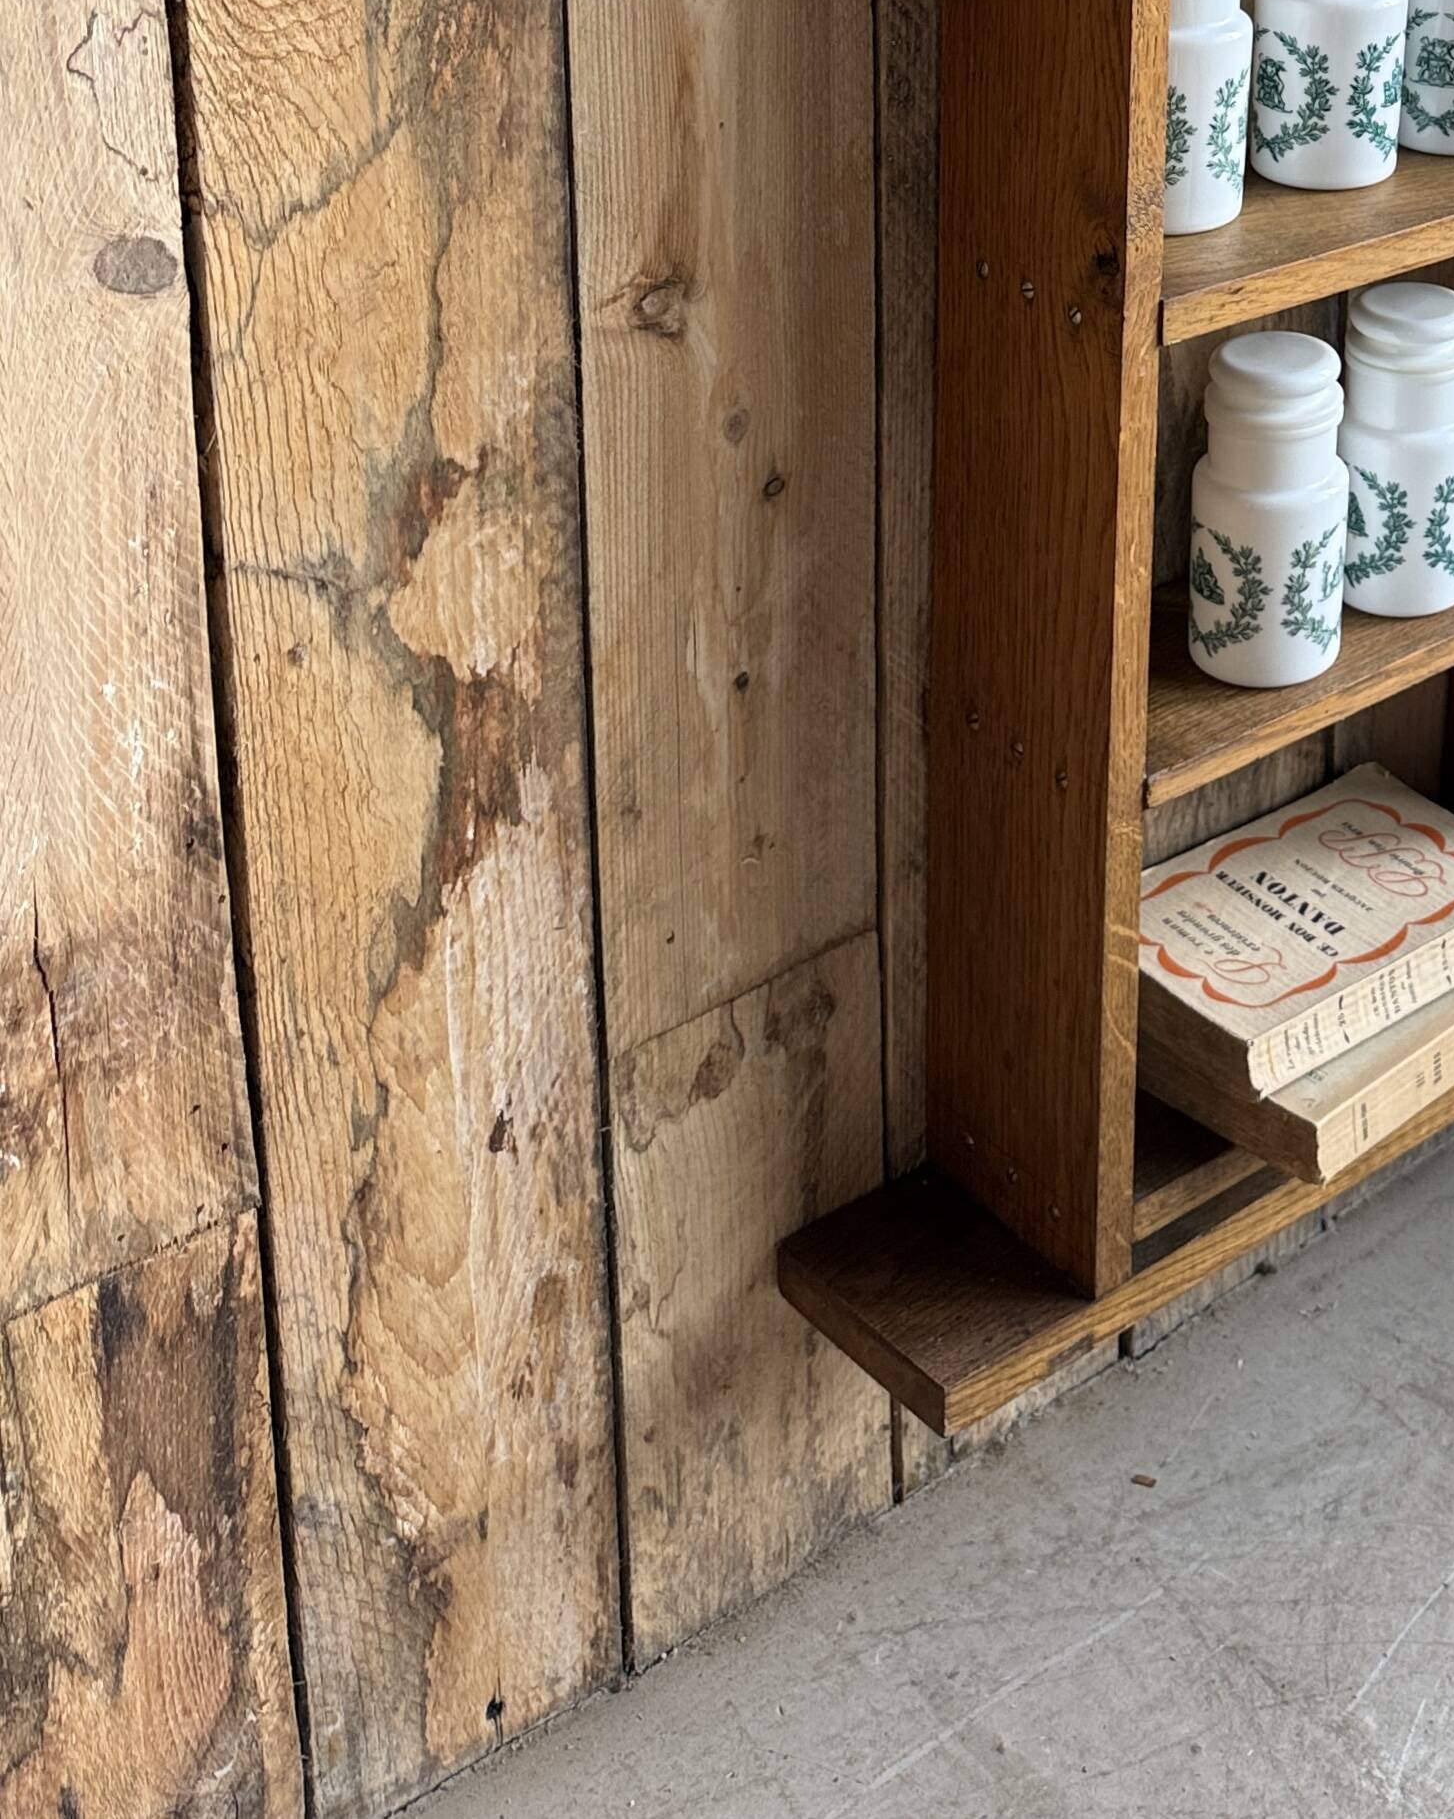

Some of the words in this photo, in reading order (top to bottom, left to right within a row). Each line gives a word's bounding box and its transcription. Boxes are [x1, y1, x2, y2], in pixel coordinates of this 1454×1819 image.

[1215, 870, 1286, 921] MONSIEUR
[1250, 871, 1345, 936] DANTON
[1311, 887, 1327, 899] par
[1330, 884, 1374, 912] JACQUES
[1162, 917, 1202, 947] roman
[1176, 909, 1224, 944] grandes
[1206, 913, 1261, 952] existences
[1284, 921, 1317, 943] BON
[1221, 940, 1241, 956] des
[1317, 941, 1339, 957] CE
